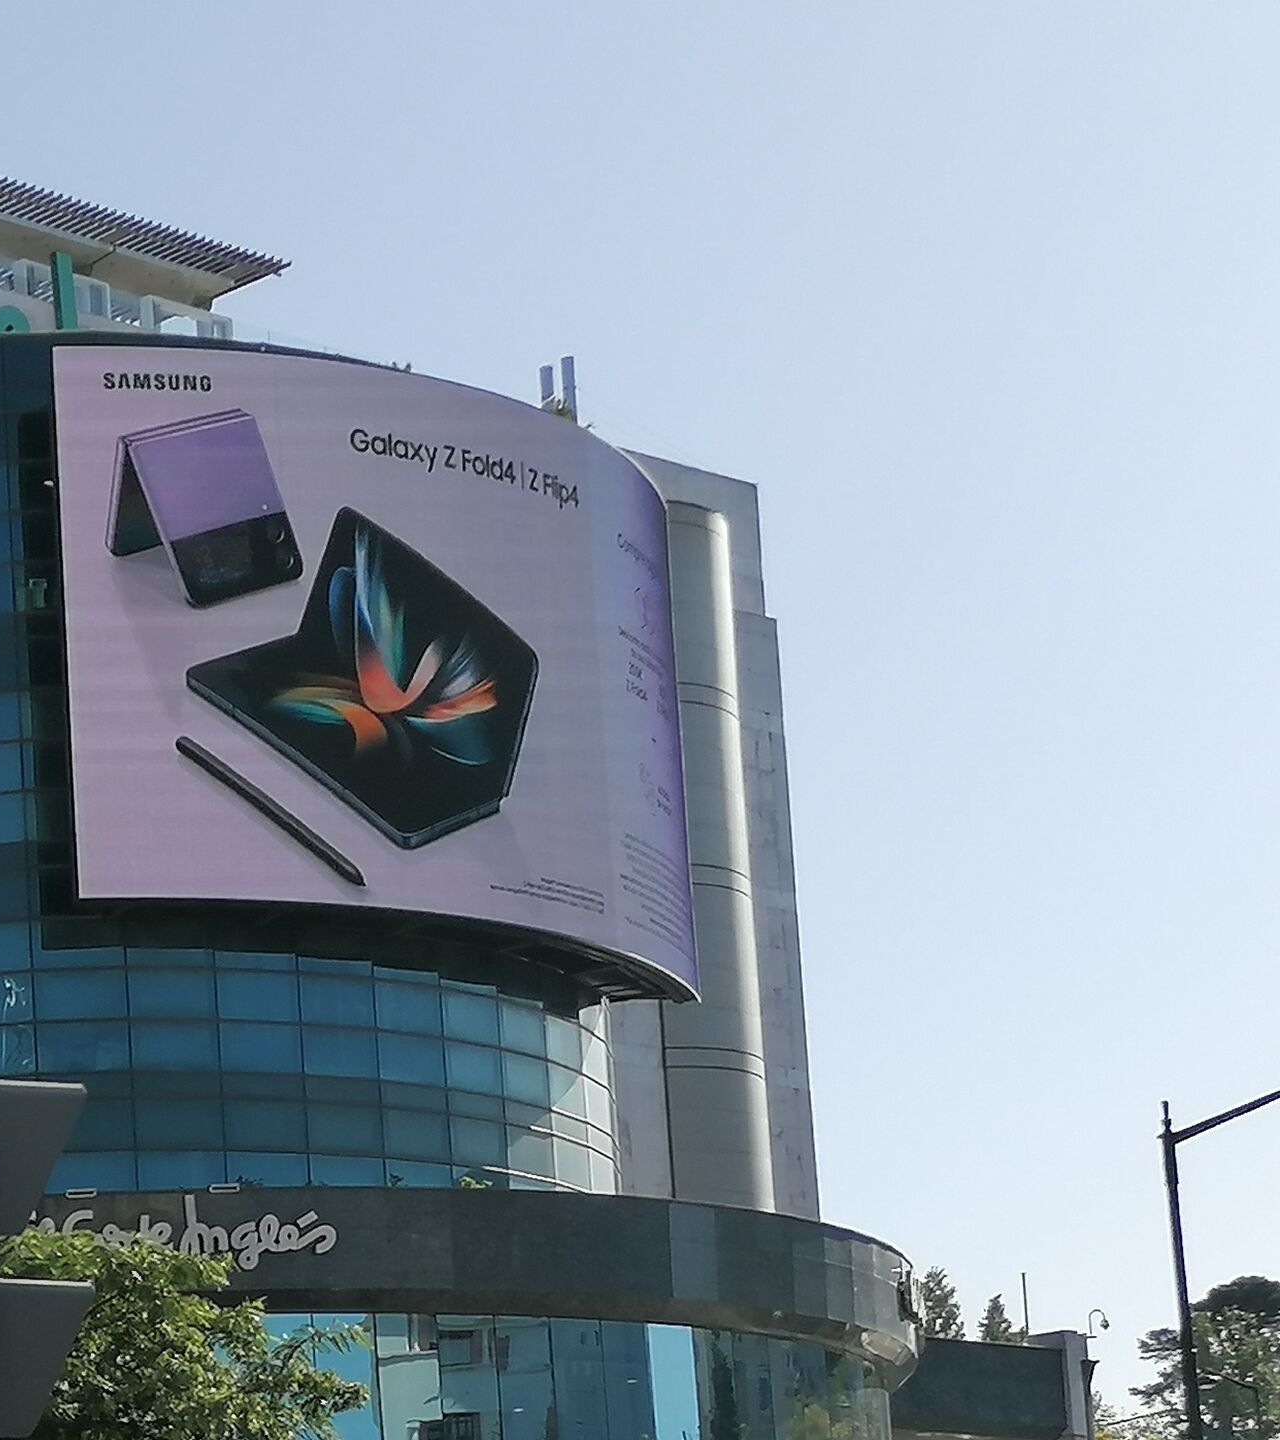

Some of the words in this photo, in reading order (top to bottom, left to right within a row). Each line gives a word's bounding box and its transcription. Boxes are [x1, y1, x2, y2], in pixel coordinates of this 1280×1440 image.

[102, 371, 213, 393] SAMSUNG
[349, 428, 438, 474] Galaxy
[443, 444, 457, 470] Z
[460, 448, 517, 486] Fold4
[527, 467, 541, 493] Z
[542, 472, 581, 510] Flip4
